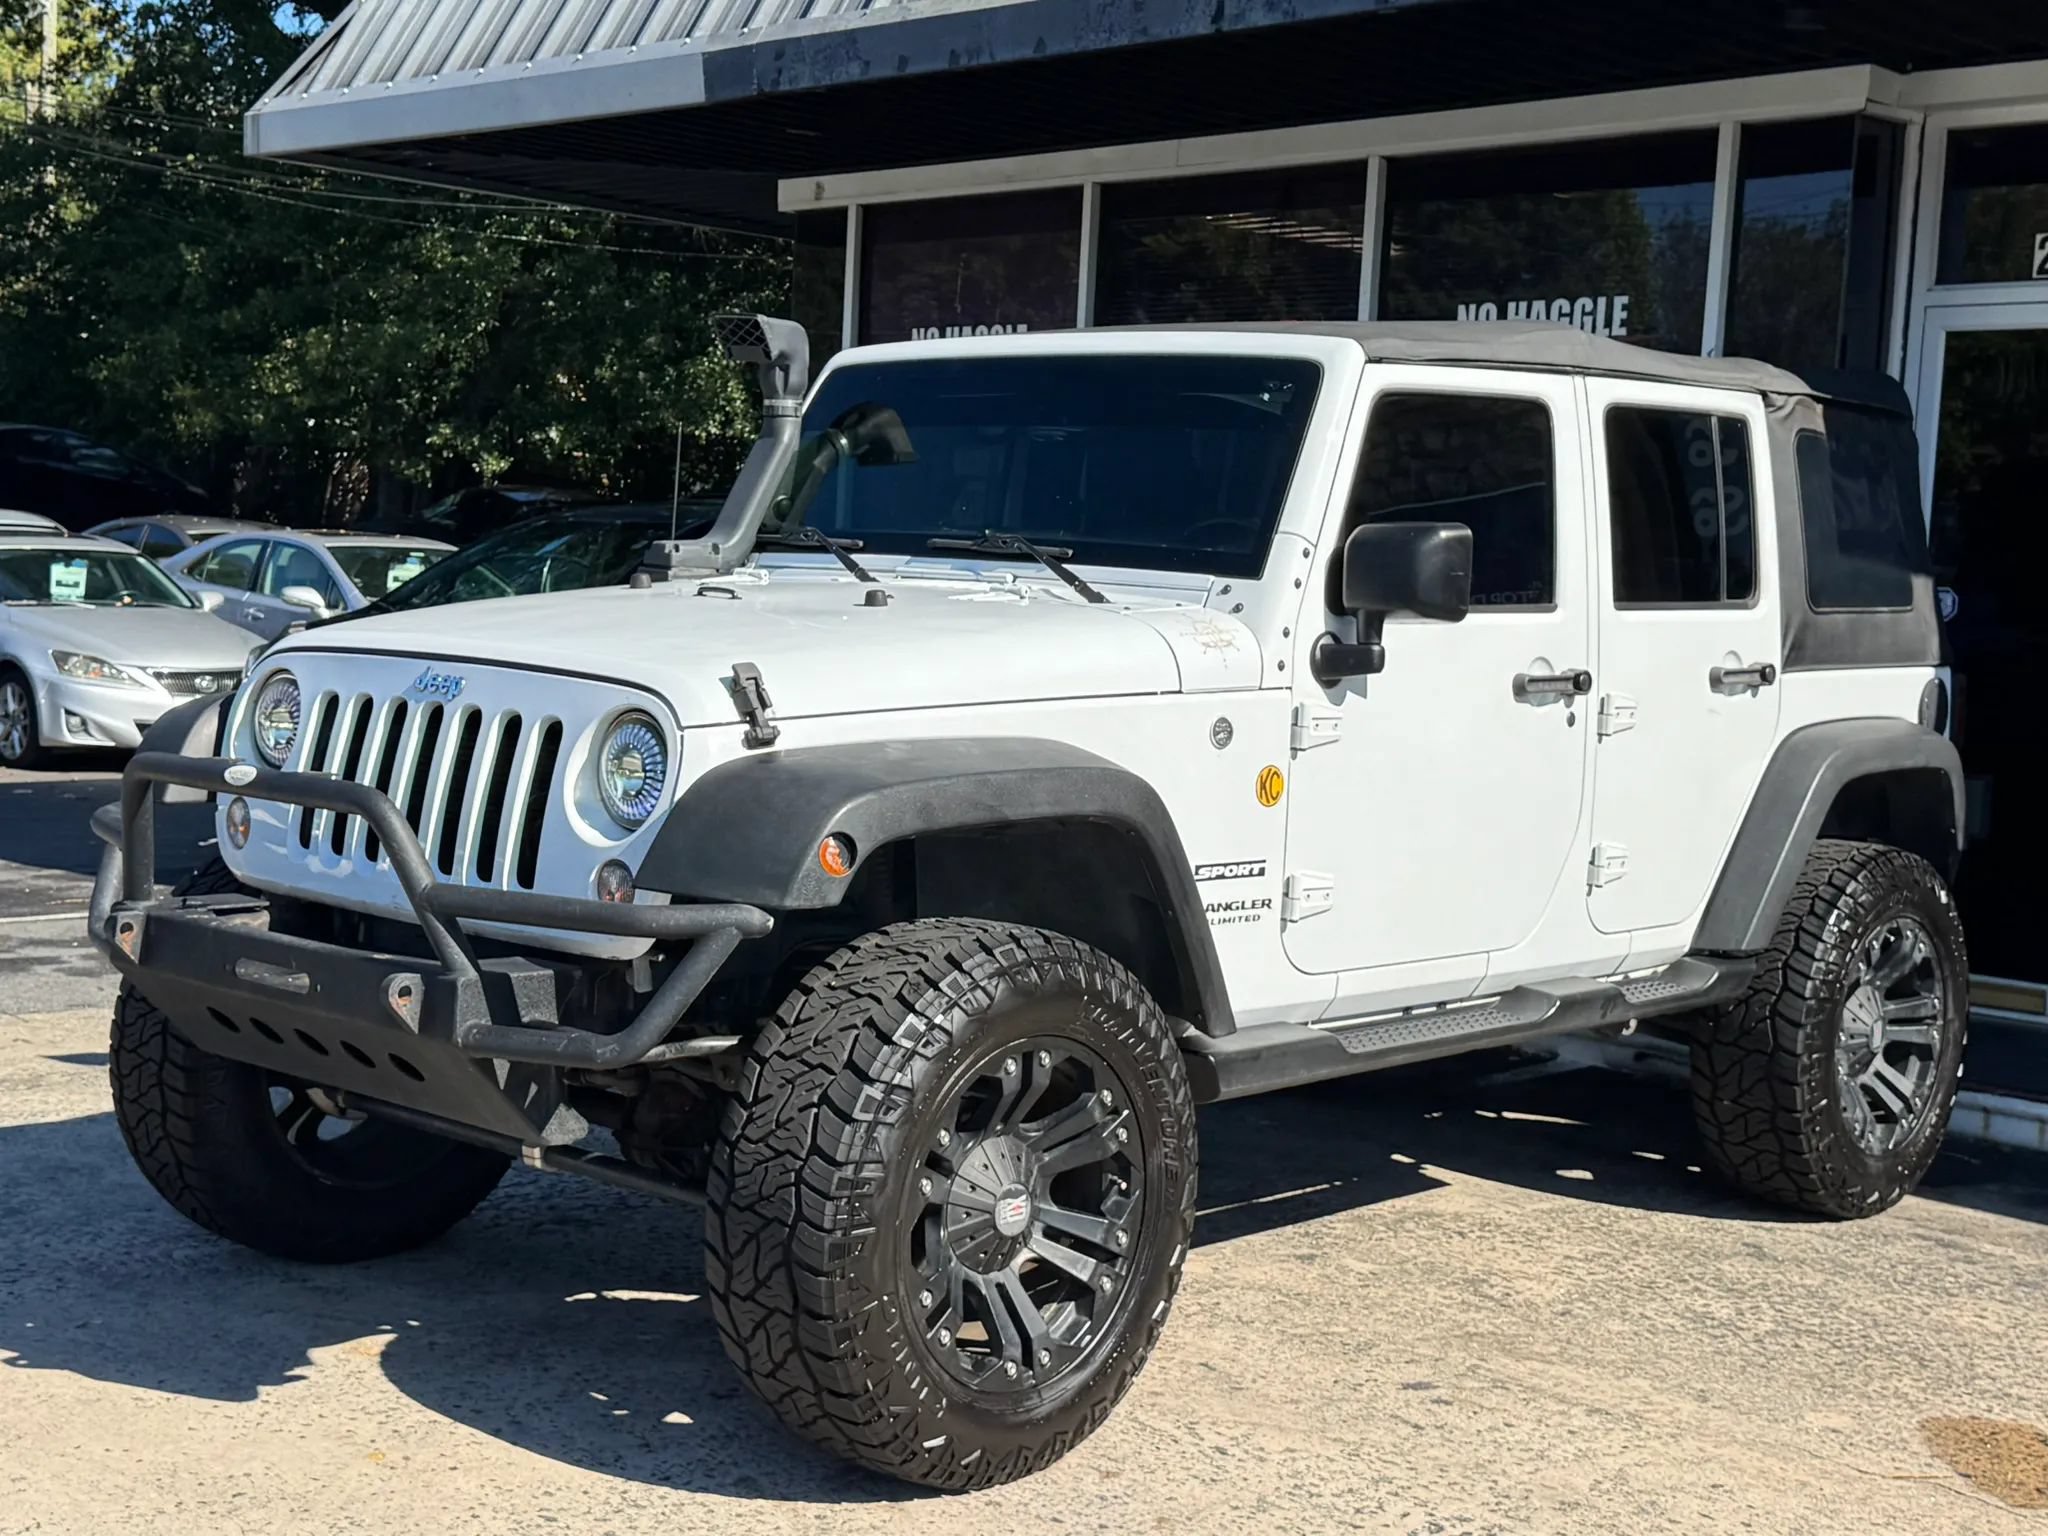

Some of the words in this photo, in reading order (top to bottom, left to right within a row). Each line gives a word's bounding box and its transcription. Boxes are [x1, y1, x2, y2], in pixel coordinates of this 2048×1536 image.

[414, 666, 466, 702] Jeep
[1259, 768, 1281, 804] KC
[1195, 862, 1266, 880] SPORT
[1205, 898, 1272, 913] ANGLER
[1210, 914, 1261, 926] LIMITED
